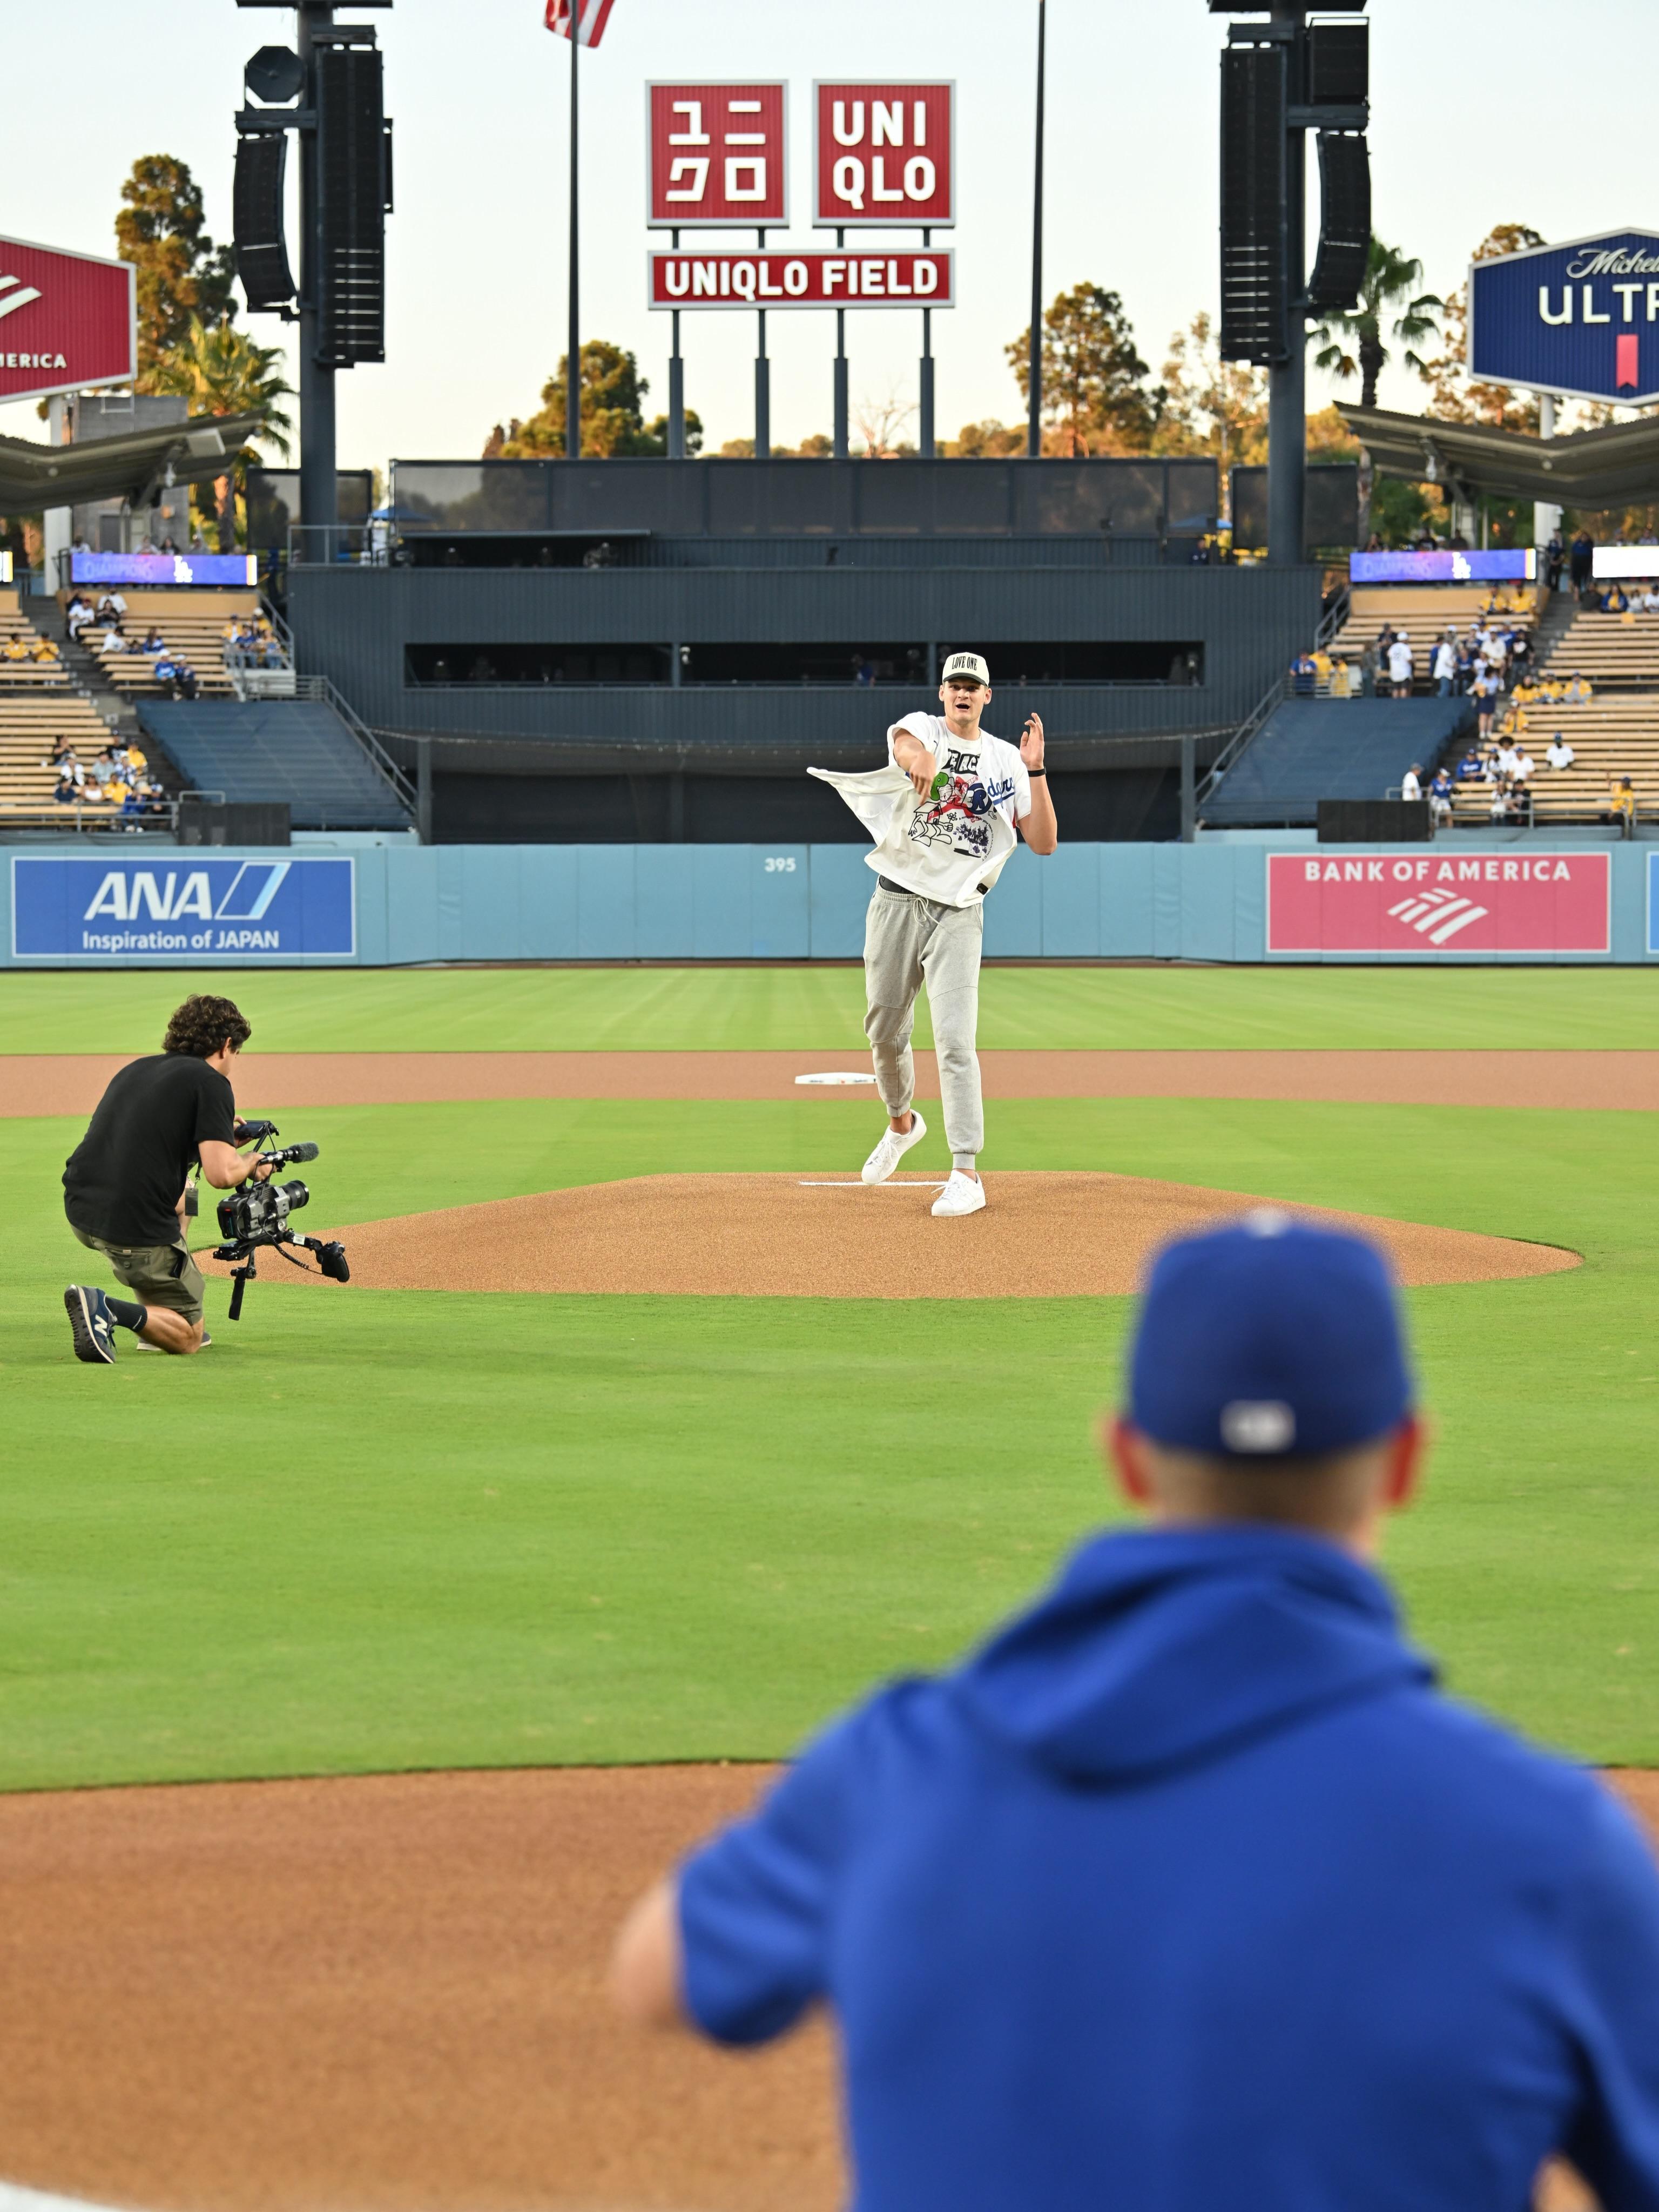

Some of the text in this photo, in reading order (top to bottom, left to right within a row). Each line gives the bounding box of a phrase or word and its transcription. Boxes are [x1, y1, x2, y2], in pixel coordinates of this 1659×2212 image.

[669, 101, 766, 145] ユニ
[833, 101, 926, 146] UNI
[665, 157, 766, 201] クロ
[833, 156, 935, 210] QLO
[665, 260, 938, 301] UNIQLO FIELD
[0, 353, 67, 368] ERICA
[952, 656, 977, 671] LOVE ONE
[765, 857, 796, 872] 395
[1305, 860, 1571, 881] BANK OF AMERICA
[84, 872, 213, 920] ANA
[83, 930, 279, 952] Inspiration of JAPAN
